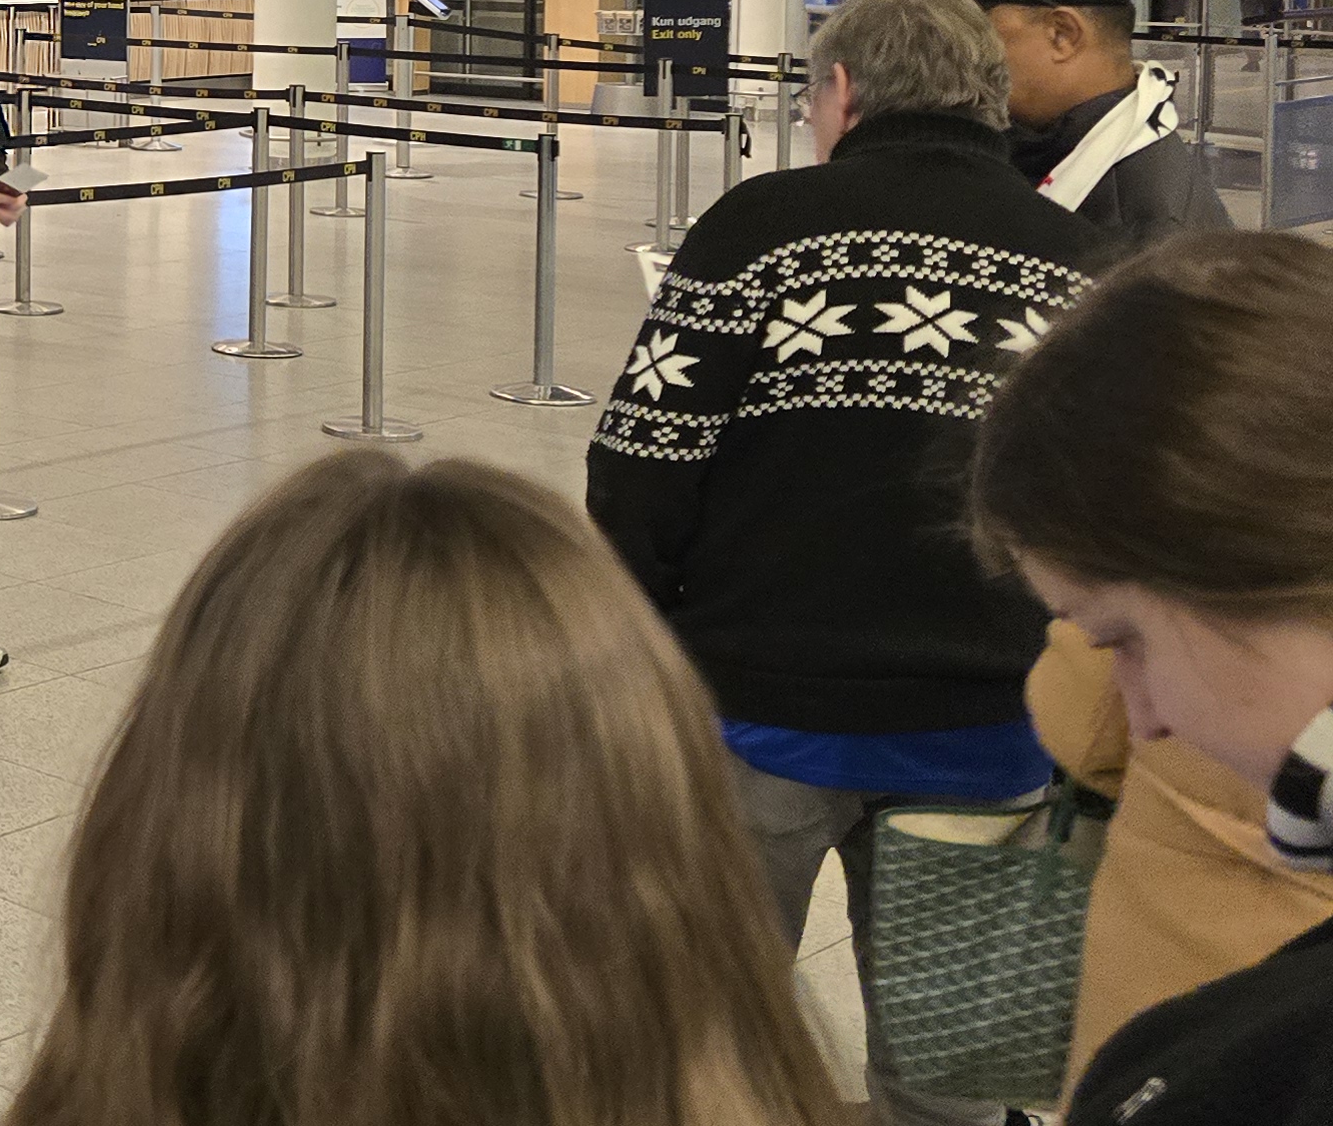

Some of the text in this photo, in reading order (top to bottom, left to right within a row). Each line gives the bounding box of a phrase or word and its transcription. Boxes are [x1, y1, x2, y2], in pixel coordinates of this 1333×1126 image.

[652, 17, 722, 27] Kun udgang
[652, 29, 703, 40] Exit only
